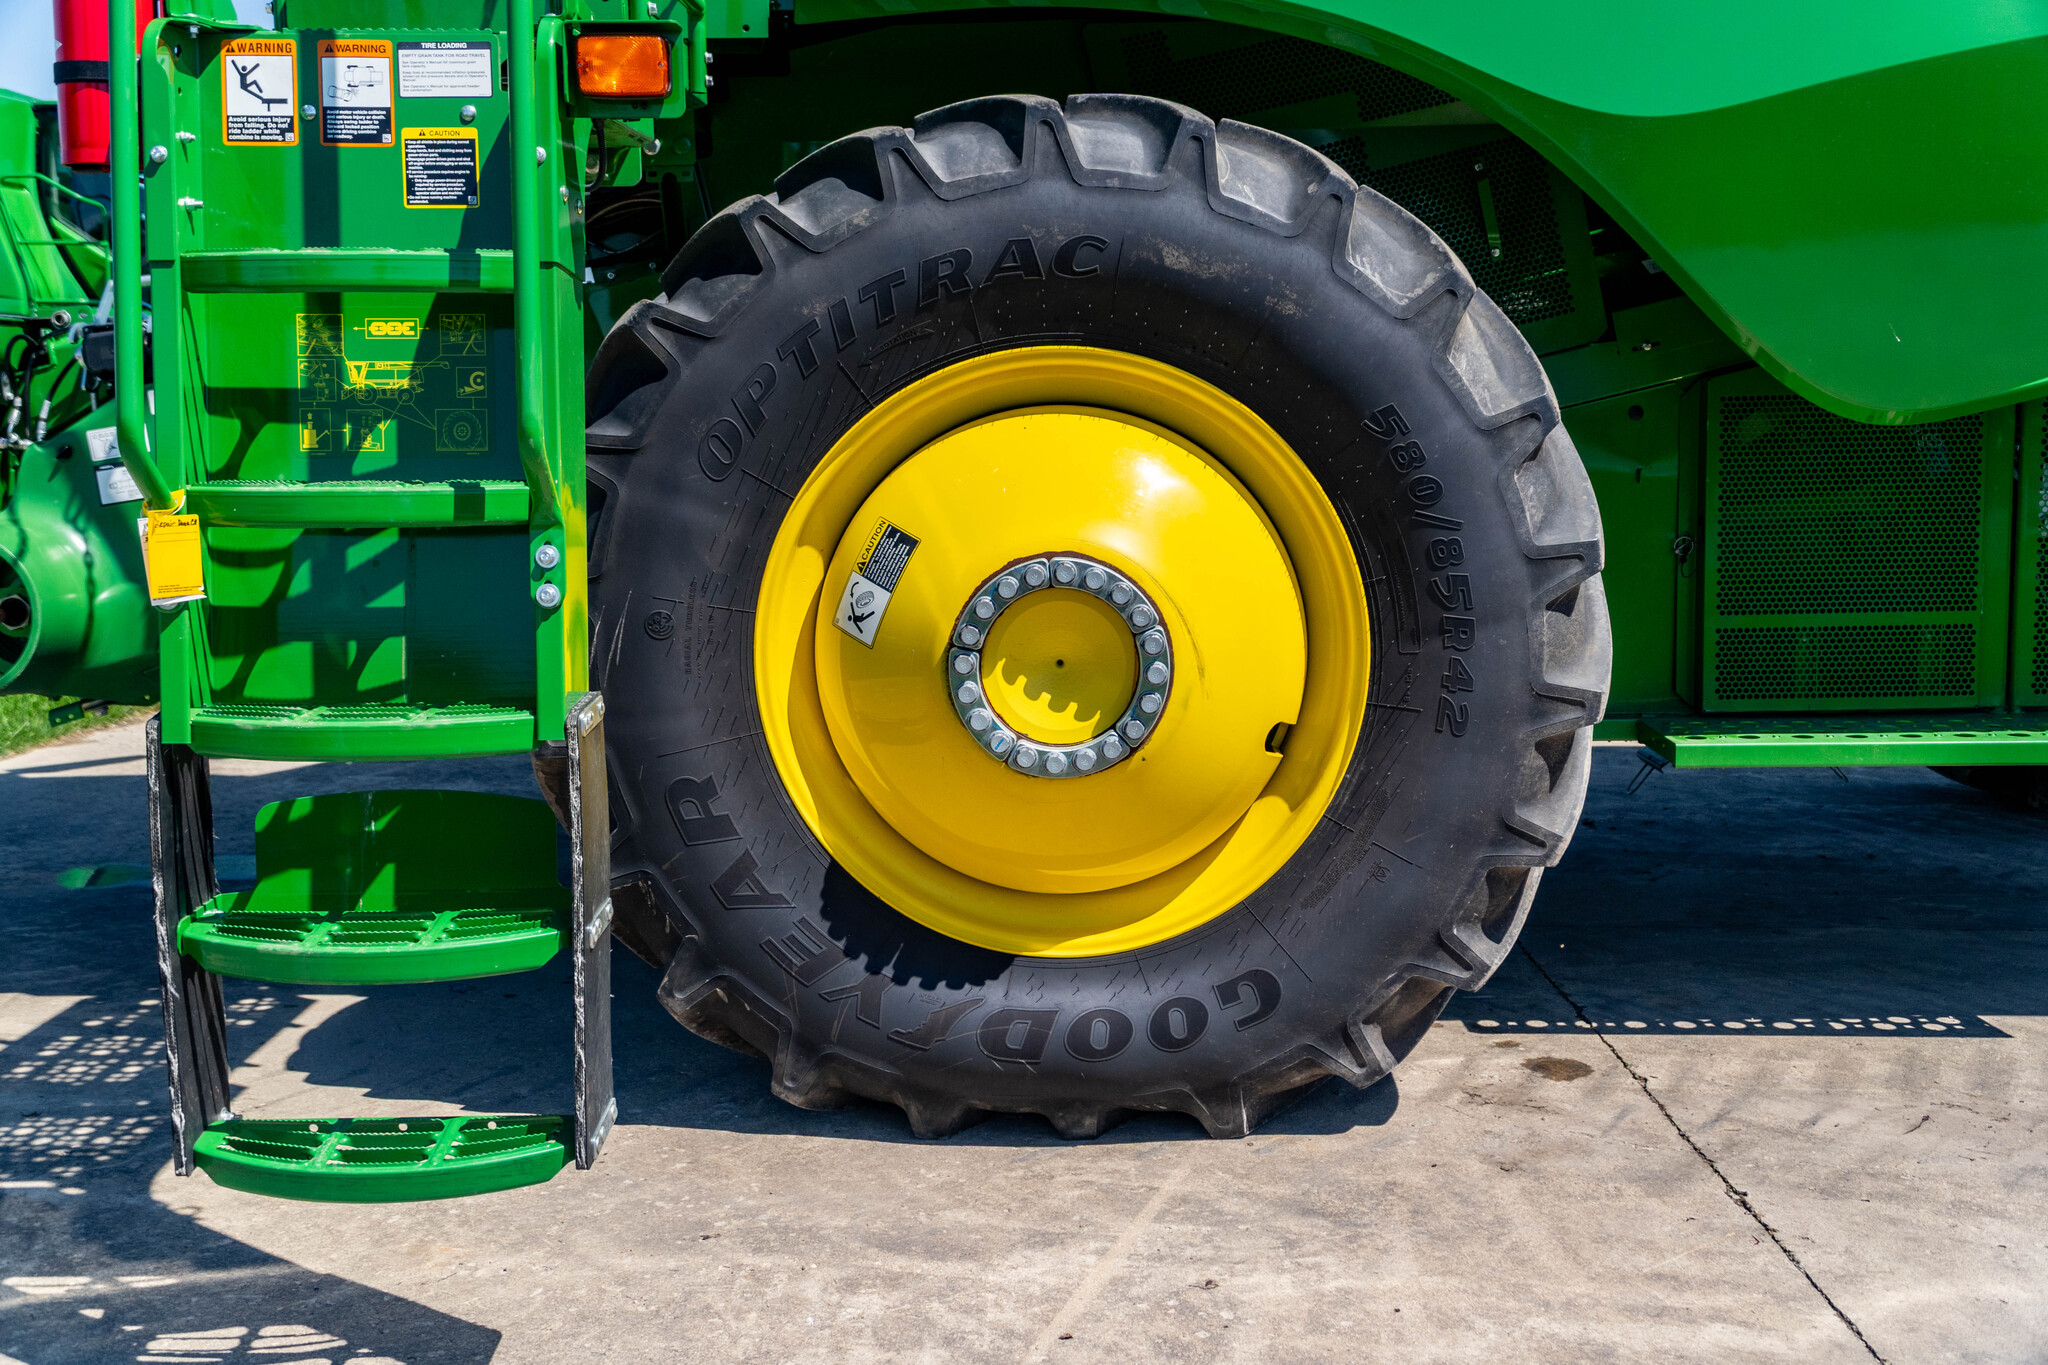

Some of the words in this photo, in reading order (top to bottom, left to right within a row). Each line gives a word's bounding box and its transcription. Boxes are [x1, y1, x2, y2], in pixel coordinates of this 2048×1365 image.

[237, 43, 292, 53] WARNING
[336, 45, 386, 53] WARNING
[698, 234, 1110, 482] OPTITRAC
[861, 520, 886, 560] CAUTION
[1361, 402, 1478, 736] 580/85R42
